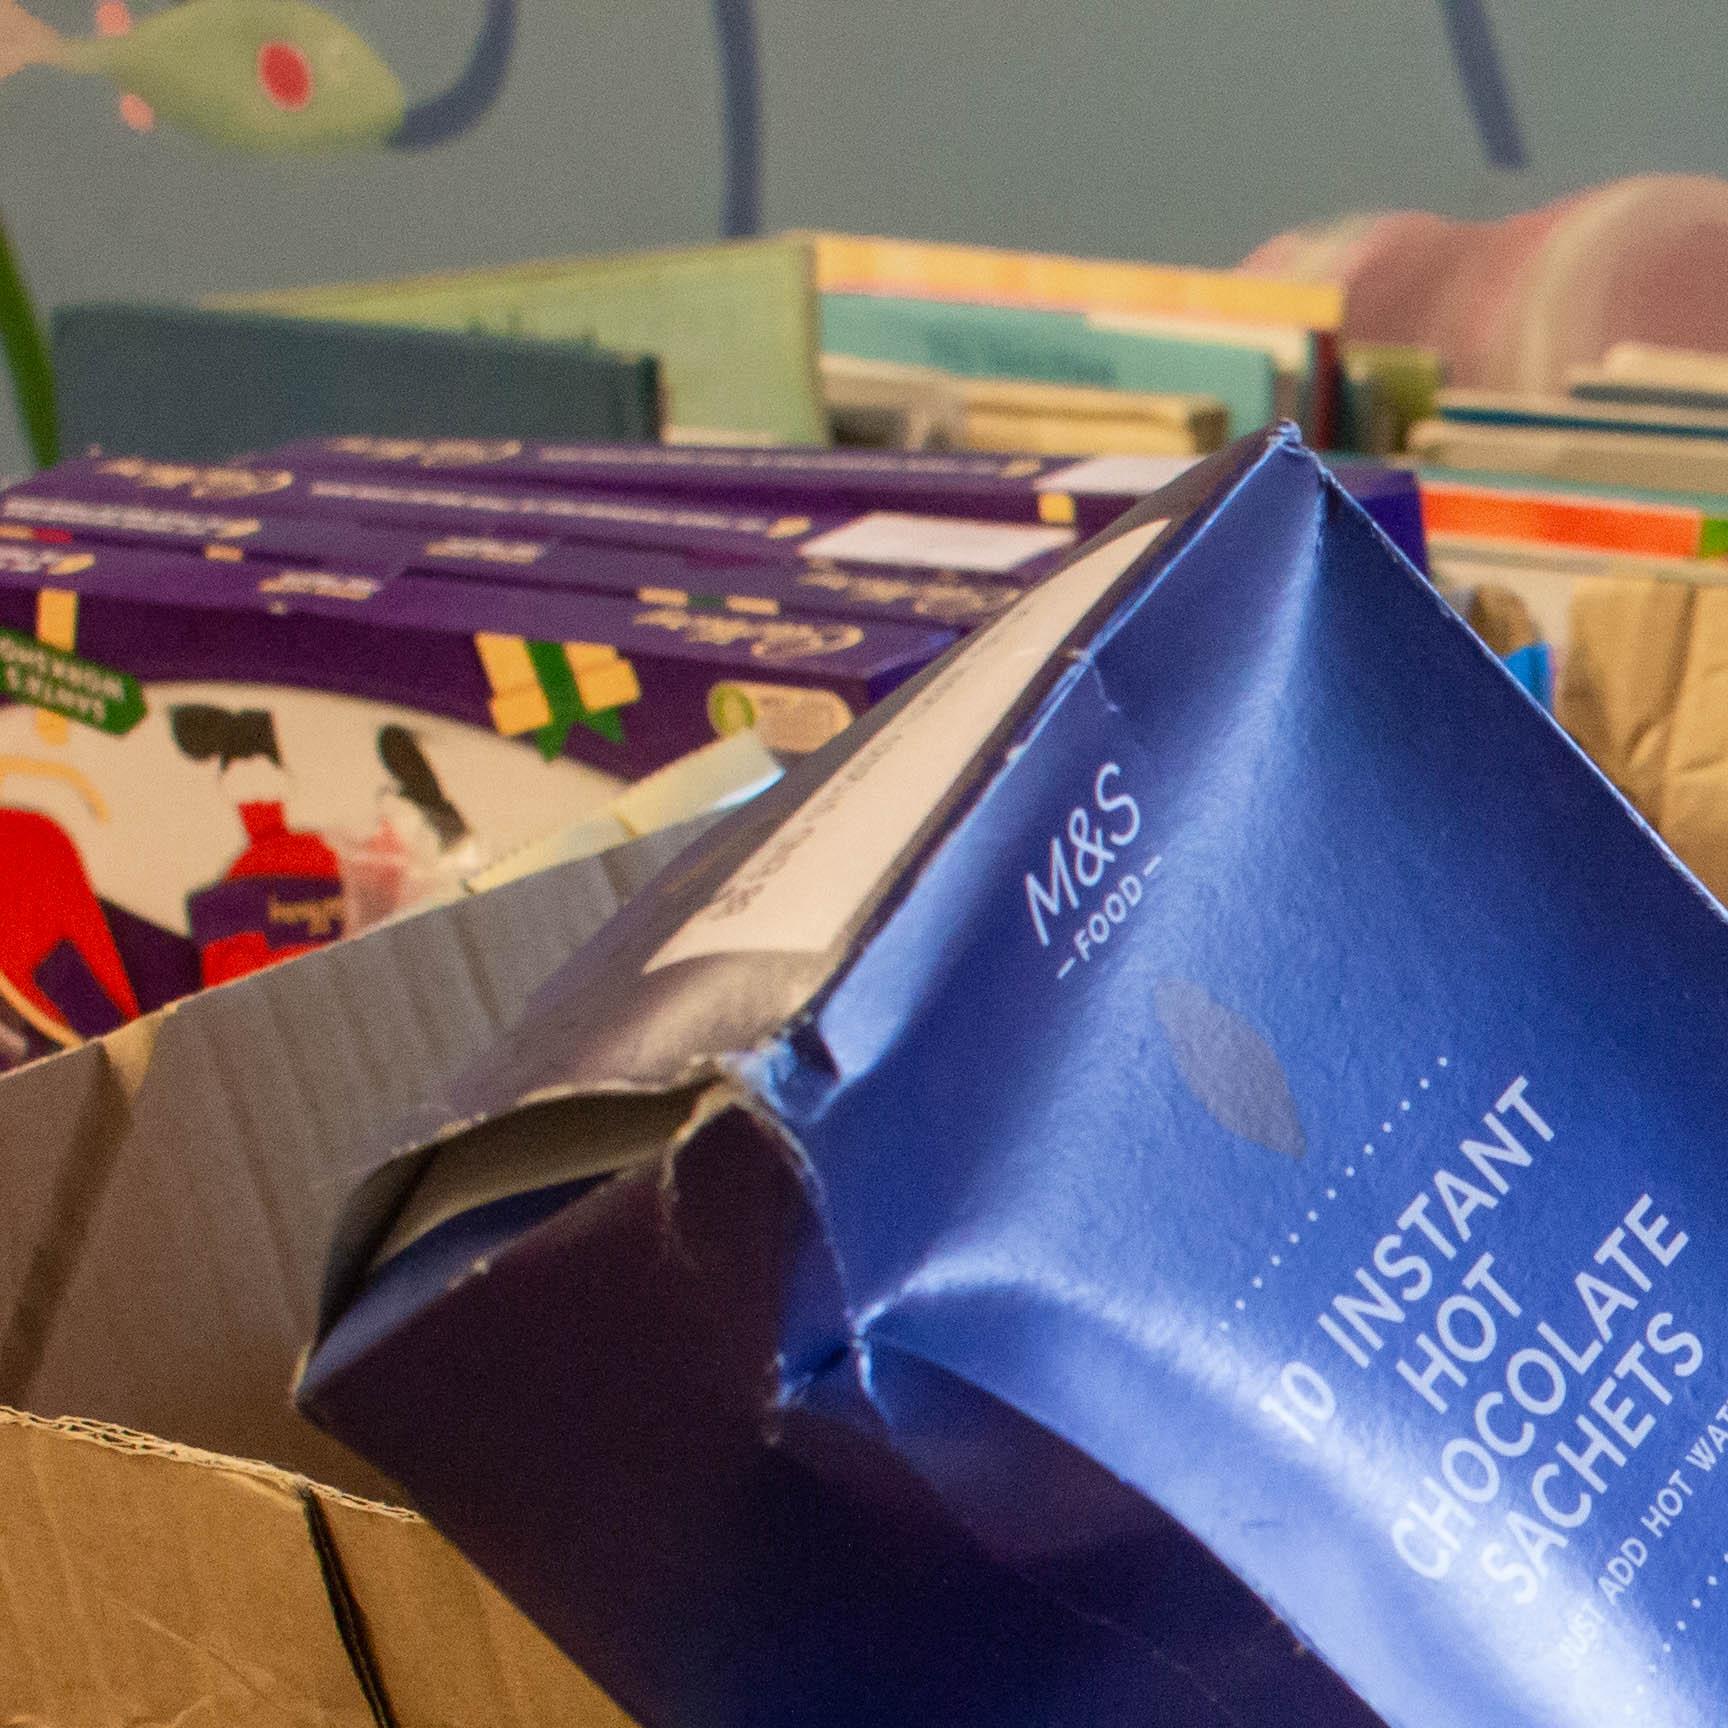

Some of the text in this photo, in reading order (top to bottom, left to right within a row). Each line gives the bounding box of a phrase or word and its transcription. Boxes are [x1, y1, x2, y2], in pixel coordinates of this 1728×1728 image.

[1022, 760, 1143, 947] M&S
[1073, 873, 1149, 963] FOOD
[1261, 1075, 1557, 1446] 10 INSTANT
[1396, 1252, 1524, 1415] HOT
[1389, 1192, 1690, 1583] CHOCOLATE
[1480, 1309, 1705, 1607] SACHETS
[1599, 1536, 1650, 1605] ADD
[1640, 1465, 1697, 1540] HOT
